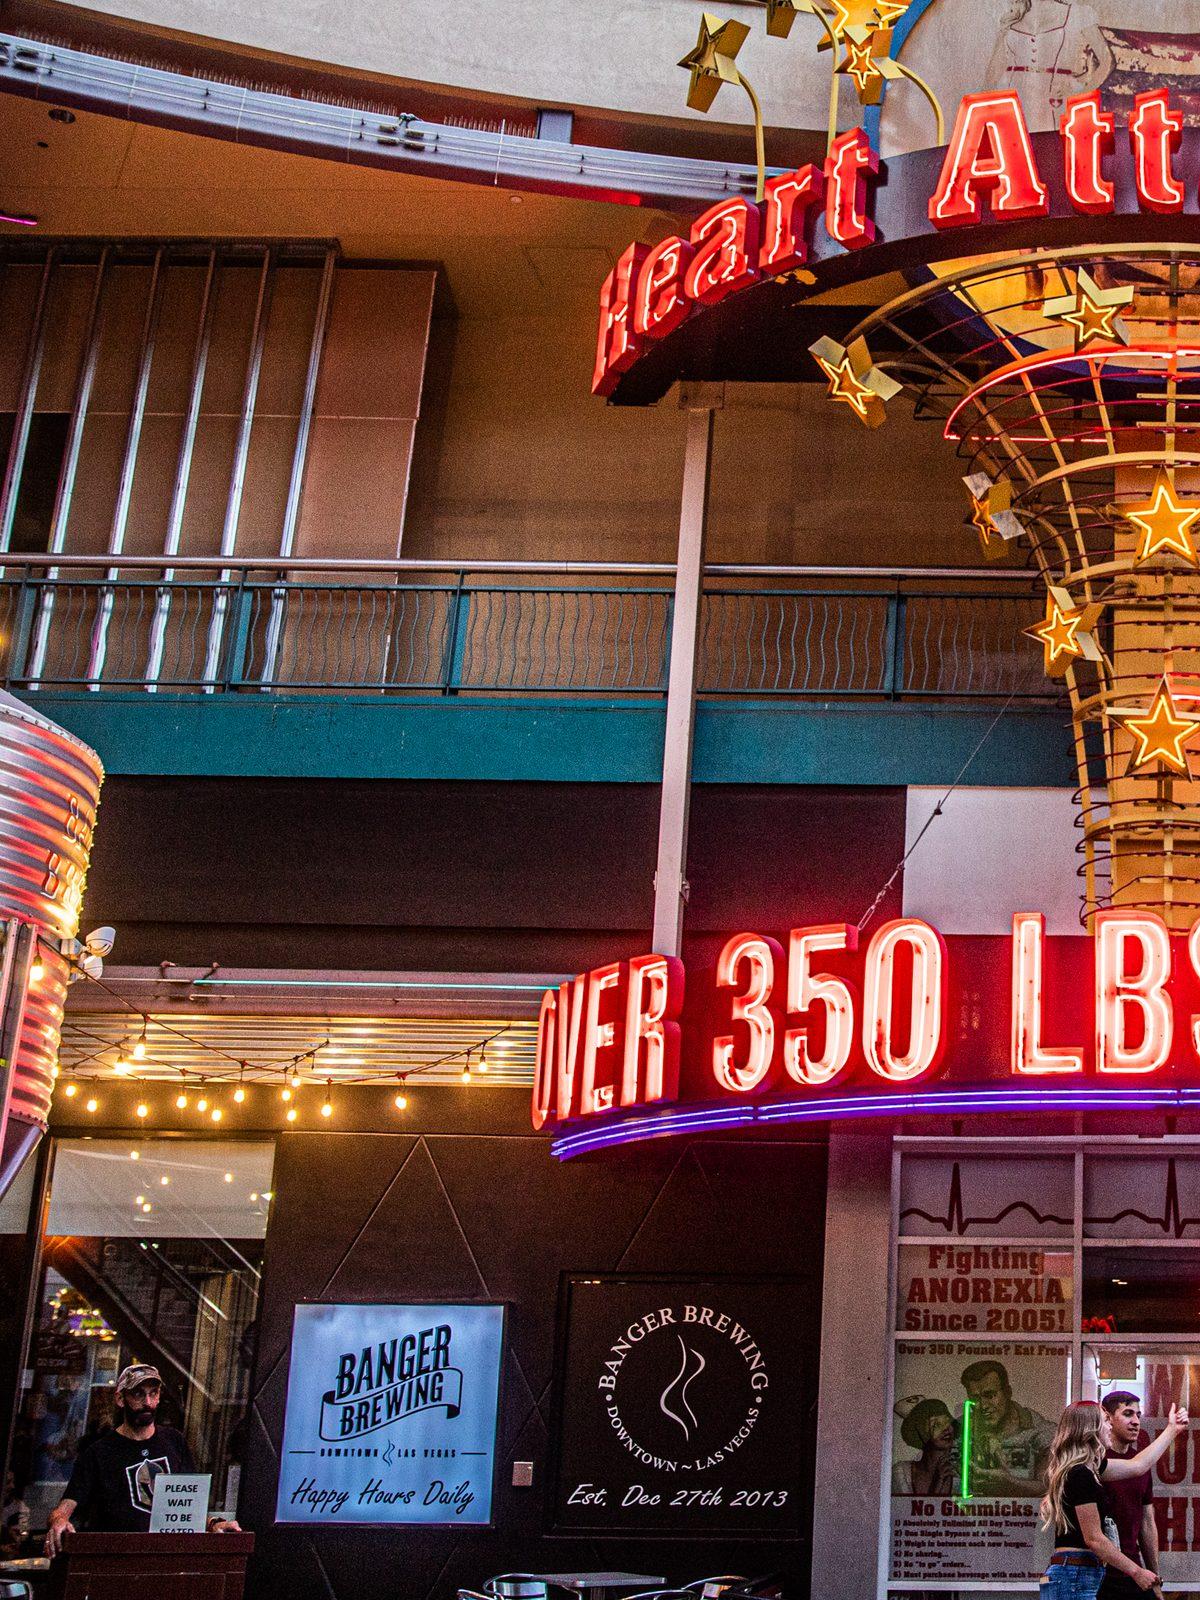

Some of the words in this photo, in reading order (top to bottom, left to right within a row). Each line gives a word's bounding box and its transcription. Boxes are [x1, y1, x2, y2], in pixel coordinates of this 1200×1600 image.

[591, 126, 879, 396] Heart
[531, 954, 685, 1131] OVER
[712, 918, 947, 1092] 350
[929, 1245, 1045, 1275] Fighting
[907, 1278, 1065, 1303] ANOREXIA
[905, 1309, 978, 1331] Since
[986, 1309, 1066, 1331] 2005!
[598, 1307, 677, 1391] BANGER
[682, 1305, 769, 1391] BREWING
[898, 1343, 925, 1355] Over
[929, 1344, 953, 1355] 350
[957, 1344, 1010, 1355] Pounds?
[1014, 1344, 1034, 1355] Eat
[336, 1324, 452, 1400] BANGER
[339, 1372, 444, 1437] BREWING
[607, 1405, 677, 1472] DOWNTOWN
[696, 1451, 725, 1471] LAS
[724, 1407, 760, 1454] VEGAS
[320, 1448, 378, 1457] DOWNTOWN
[398, 1449, 416, 1457] LAS
[424, 1449, 456, 1458] VEGAS
[168, 1499, 193, 1507] WAIT
[291, 1477, 349, 1513] Happy
[357, 1477, 416, 1505] Hours
[423, 1480, 475, 1514] Daily
[567, 1483, 608, 1507] Est.
[621, 1484, 661, 1507] Dec
[669, 1487, 723, 1507] 27th
[729, 1490, 789, 1507] 2013
[165, 1514, 178, 1522] TO
[180, 1514, 192, 1522] BE
[911, 1500, 934, 1516] No
[990, 1520, 1003, 1528] Day
[904, 1540, 926, 1548] Weigh
